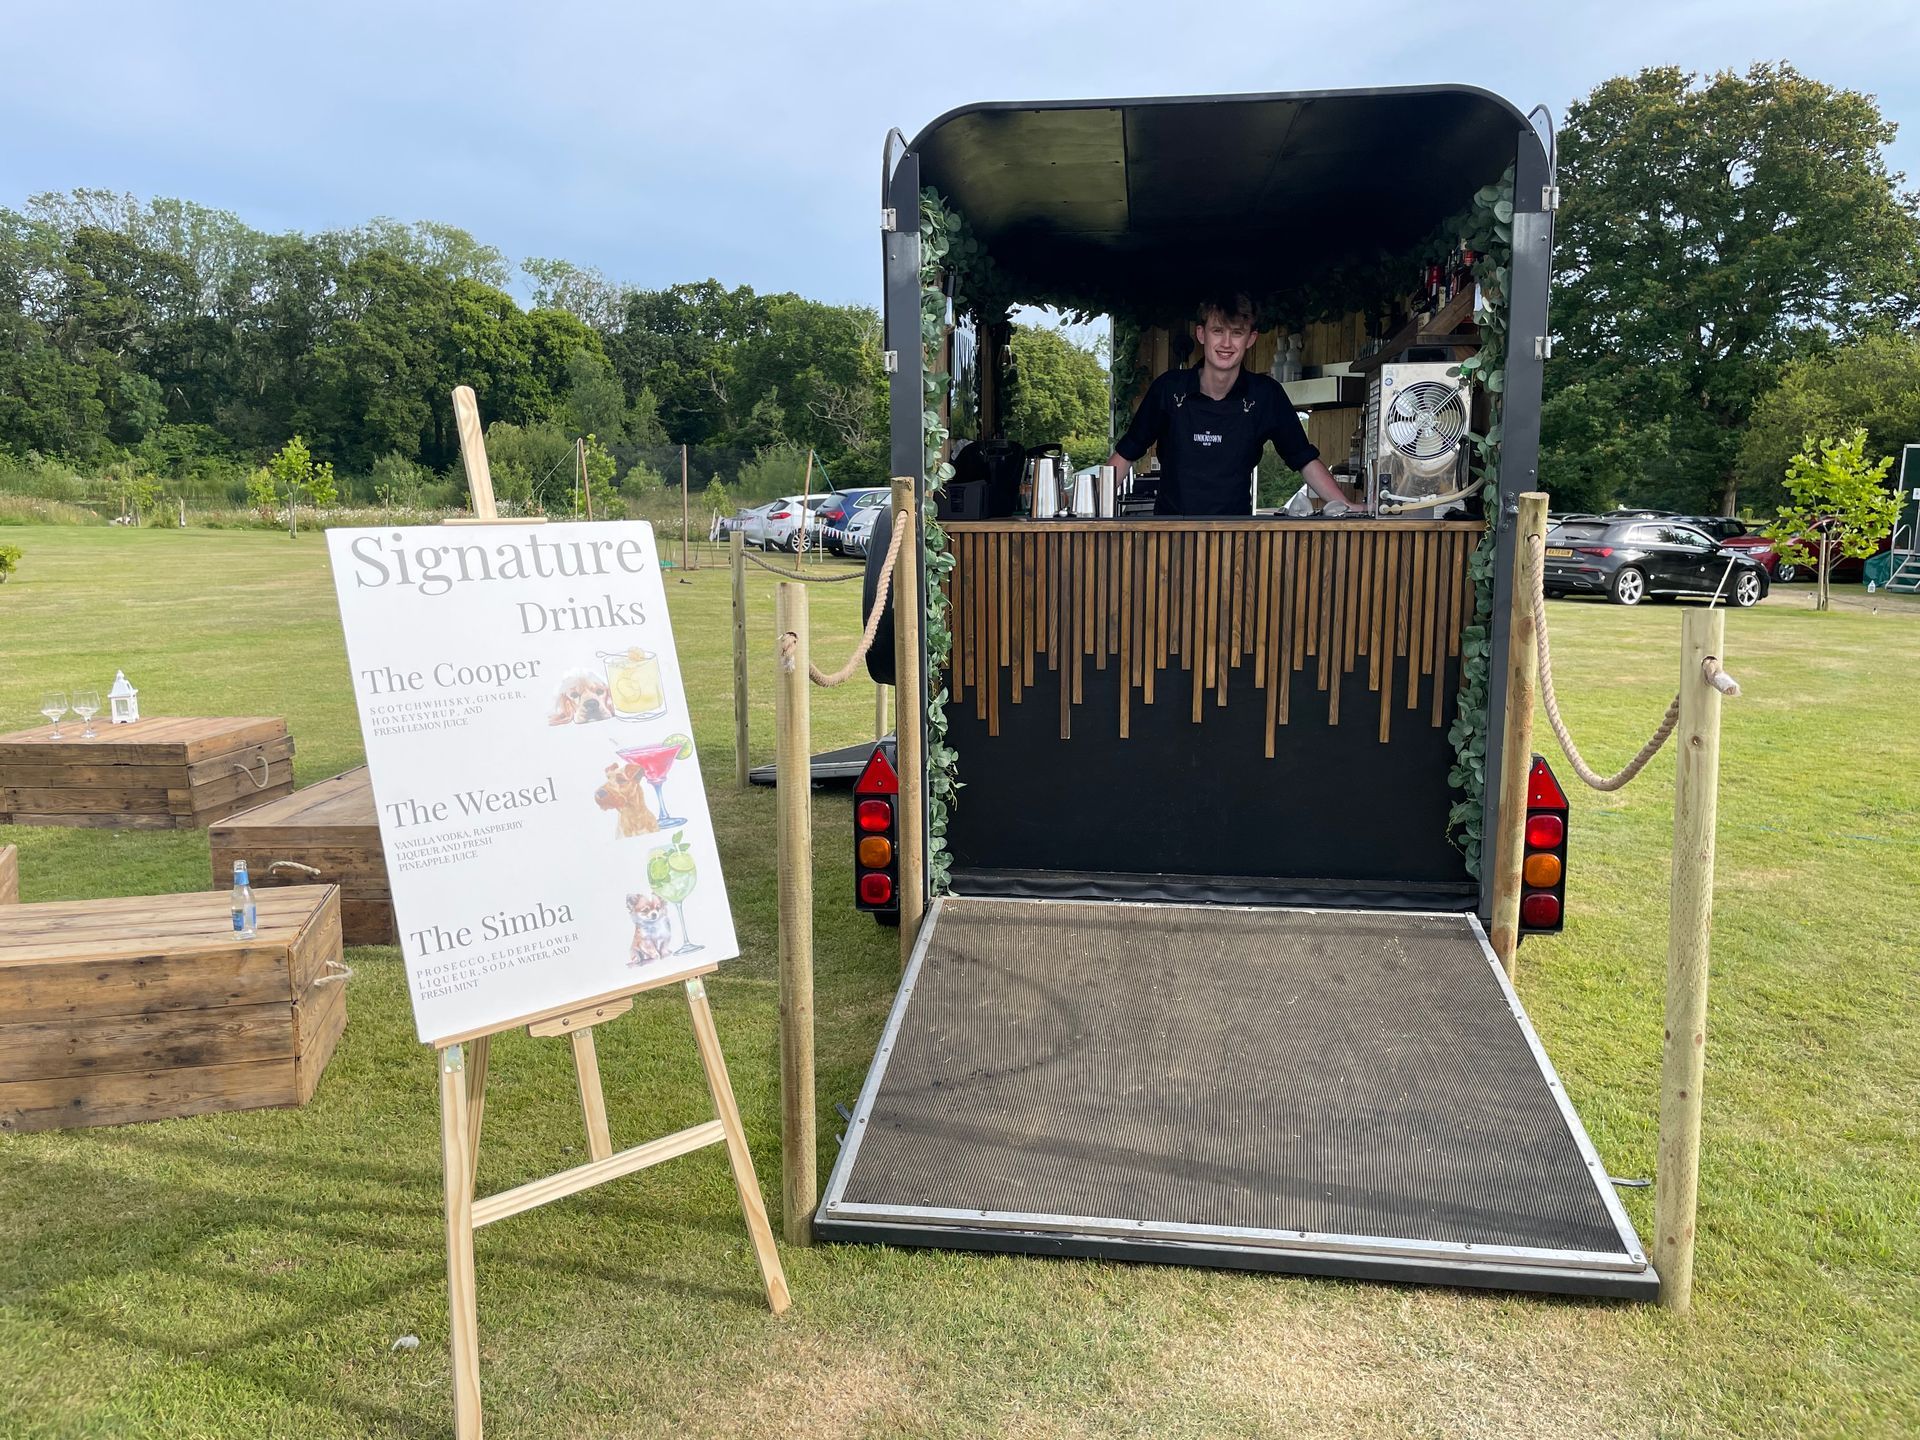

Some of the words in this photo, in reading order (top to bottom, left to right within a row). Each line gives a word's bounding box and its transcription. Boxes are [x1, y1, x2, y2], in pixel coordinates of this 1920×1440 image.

[351, 532, 645, 596] Signature
[516, 594, 647, 634] Drinks
[361, 666, 425, 695] The
[434, 659, 541, 689] Cooper
[464, 705, 484, 716] AND
[374, 724, 407, 737] FRESH
[408, 721, 441, 733] LEMON
[443, 717, 469, 730] JUICE
[386, 797, 449, 829] The
[454, 777, 559, 817] Weasel
[394, 836, 436, 851] VANILLA
[436, 830, 472, 843] VODKA,
[473, 820, 524, 837] RASPBERRY
[397, 846, 440, 862] LIQUEUR
[441, 842, 461, 854] AND
[463, 836, 493, 849] FRESH
[399, 855, 451, 872] PINEAPPLE
[452, 850, 479, 864] JUICE
[410, 924, 473, 958] The
[481, 902, 575, 942] Simba
[482, 957, 516, 975] SODA
[552, 945, 571, 957] AND
[491, 932, 580, 961] ELDERFLOWER
[421, 985, 453, 1001] FRESH
[454, 979, 480, 993] MINT
